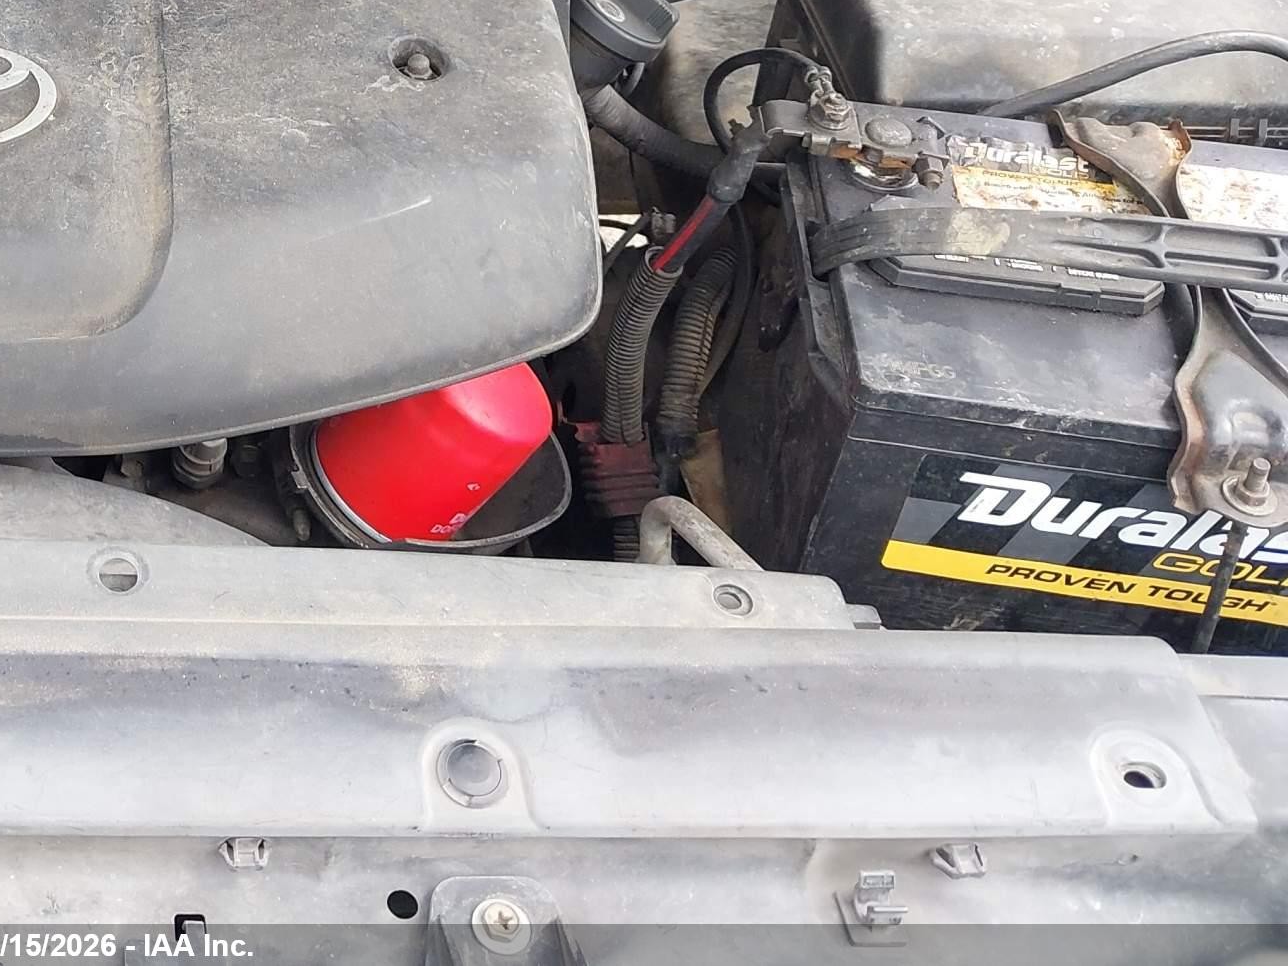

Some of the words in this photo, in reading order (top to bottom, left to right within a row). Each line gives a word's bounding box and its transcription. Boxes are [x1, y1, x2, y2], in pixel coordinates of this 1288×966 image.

[965, 142, 1089, 173] Duralast
[986, 563, 1136, 594] PROVEN
[1153, 552, 1288, 587] GOL
